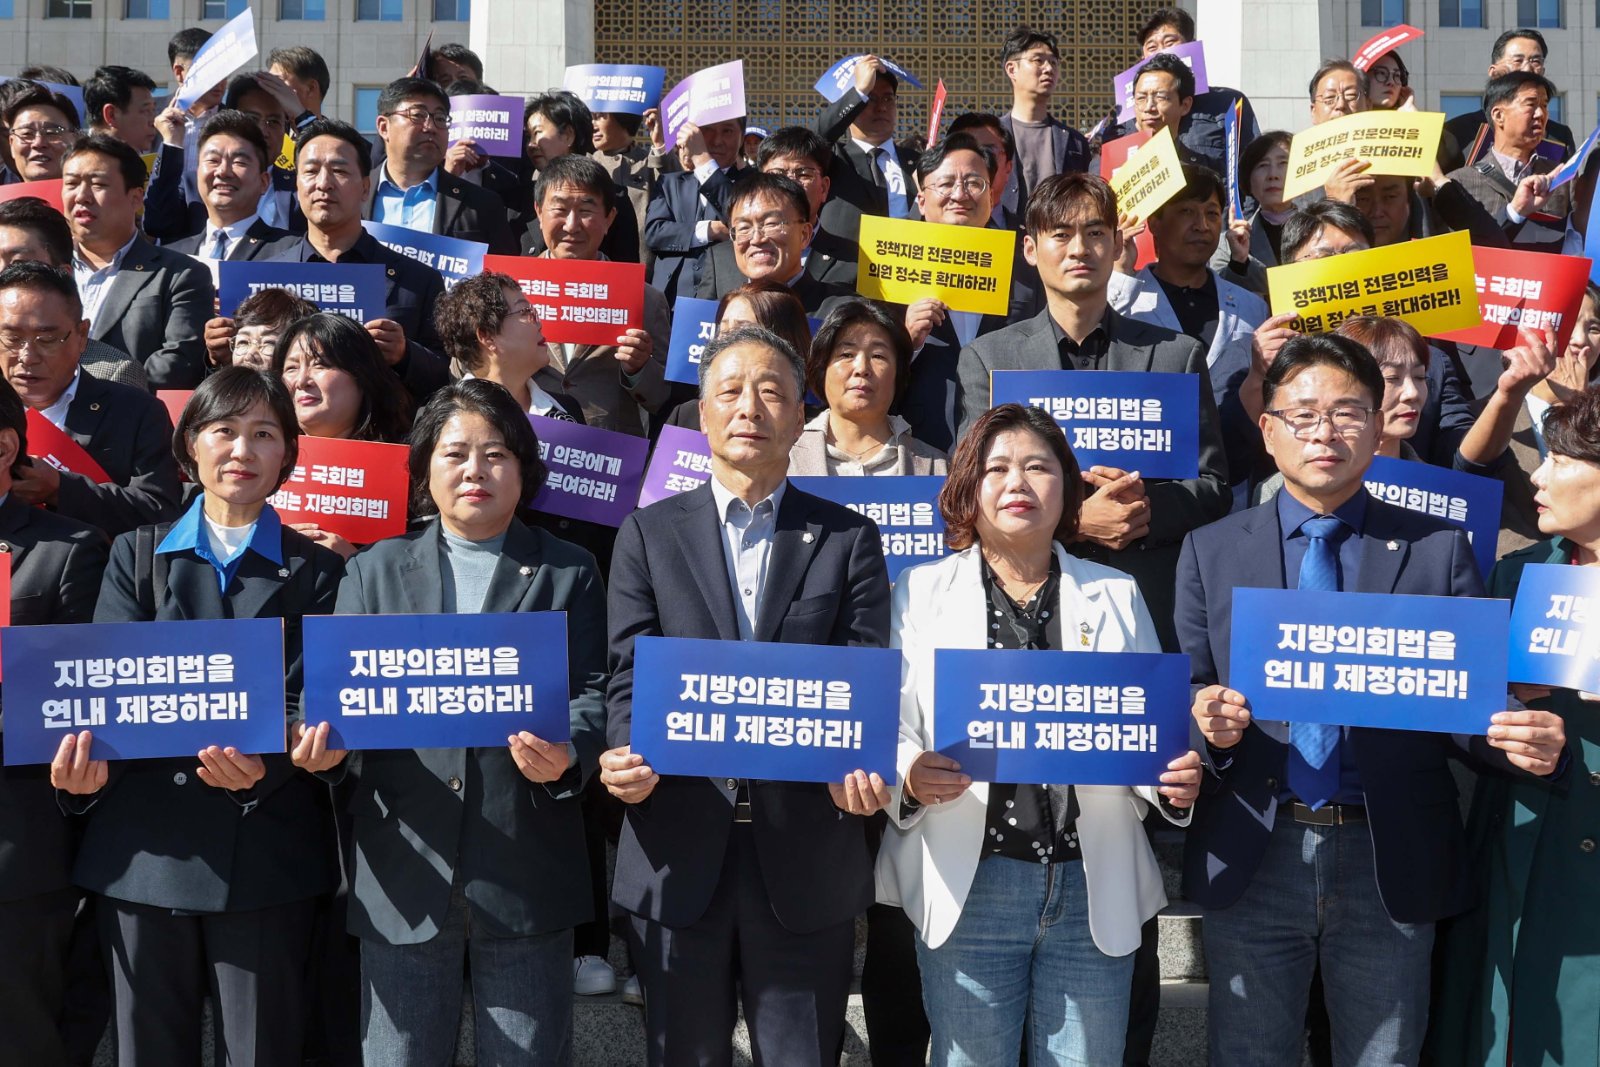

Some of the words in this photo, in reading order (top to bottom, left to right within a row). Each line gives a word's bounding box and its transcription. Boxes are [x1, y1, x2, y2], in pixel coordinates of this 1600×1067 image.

[1304, 131, 1349, 157] 정책지원
[1352, 127, 1420, 141] 전문인력을
[1295, 159, 1317, 178] 의원
[1359, 145, 1423, 159] 확대하라!
[1125, 167, 1170, 212] 확대하라!
[876, 239, 924, 261] 정책지원
[928, 246, 993, 268] 전문인력을
[564, 282, 609, 300] 국회법
[868, 262, 892, 280] 의원
[896, 266, 932, 286] 정수로
[935, 270, 997, 293] 확대하라!
[1292, 280, 1361, 309] 정책지원
[1363, 262, 1449, 296] 전문인력을
[1490, 275, 1543, 300] 국회법
[560, 305, 629, 325] 지방의회법!
[1382, 288, 1461, 317] 확대하라!
[1483, 303, 1563, 332] 지방의회법!
[1072, 427, 1172, 452] 제정하라!
[311, 464, 364, 488] 국회법
[552, 445, 623, 476] 의장에게
[546, 471, 617, 503] 부여하라!
[304, 493, 389, 520] 지방의회법!
[1277, 623, 1456, 660] 지방의회법을
[1528, 627, 1581, 657] 연내
[54, 653, 234, 688] 지방의회법을
[350, 646, 519, 678] 지방의회법을
[679, 673, 851, 710] 지방의회법을
[1264, 659, 1325, 690] 연내
[1333, 664, 1468, 700] 제정하라!
[41, 698, 106, 729] 연내
[115, 691, 248, 725] 제정하라!
[339, 687, 398, 716] 연내
[406, 684, 533, 715] 제정하라!
[978, 683, 1146, 715] 지방의회법을
[665, 711, 726, 742] 연내
[734, 715, 862, 749] 제정하라!
[967, 720, 1026, 749] 연내
[1034, 722, 1157, 752] 제정하라!
